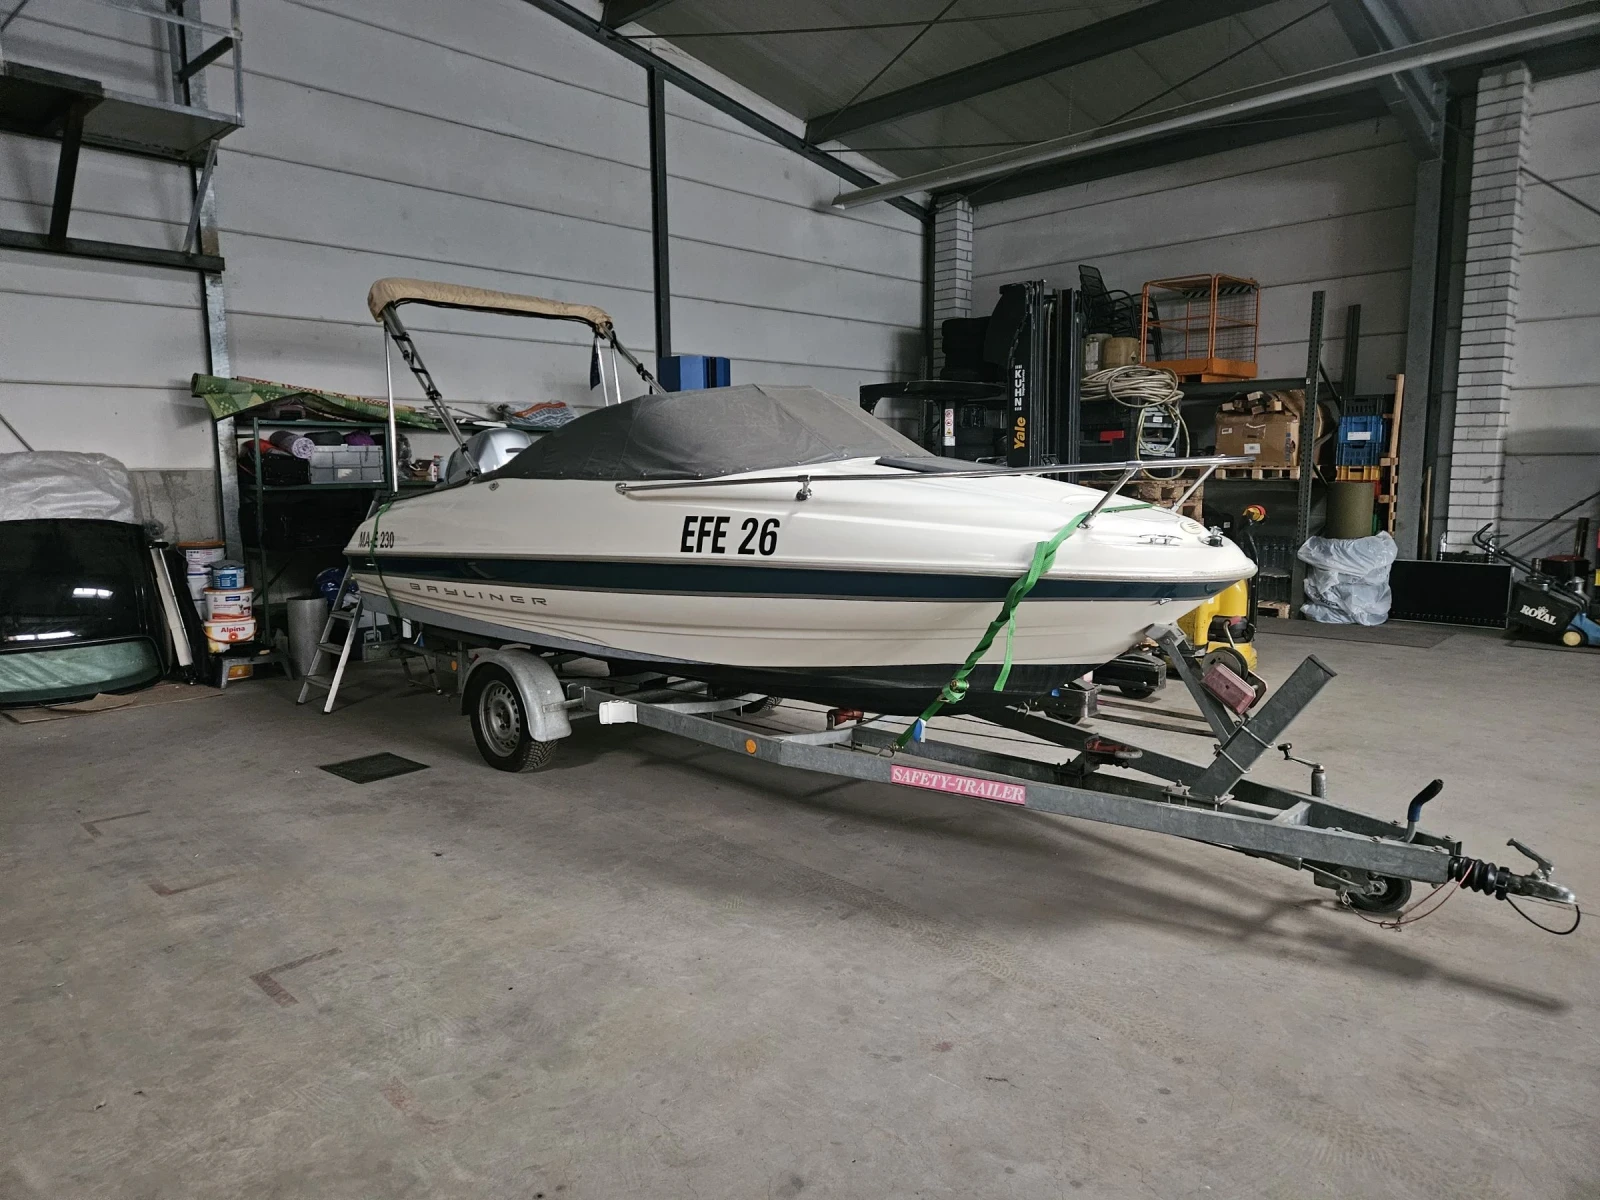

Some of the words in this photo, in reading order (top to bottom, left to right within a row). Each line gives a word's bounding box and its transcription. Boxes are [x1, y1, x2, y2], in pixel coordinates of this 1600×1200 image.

[1014, 369, 1022, 407] KUHN
[1013, 416, 1026, 449] Yale
[379, 531, 395, 548] 230
[680, 515, 731, 554] EFE
[737, 517, 781, 556] 26
[409, 582, 548, 606] BAYLINER
[220, 625, 246, 633] Alpina
[1520, 604, 1557, 626] ROYAL
[892, 768, 1024, 801] SAFETY-TRAILER
